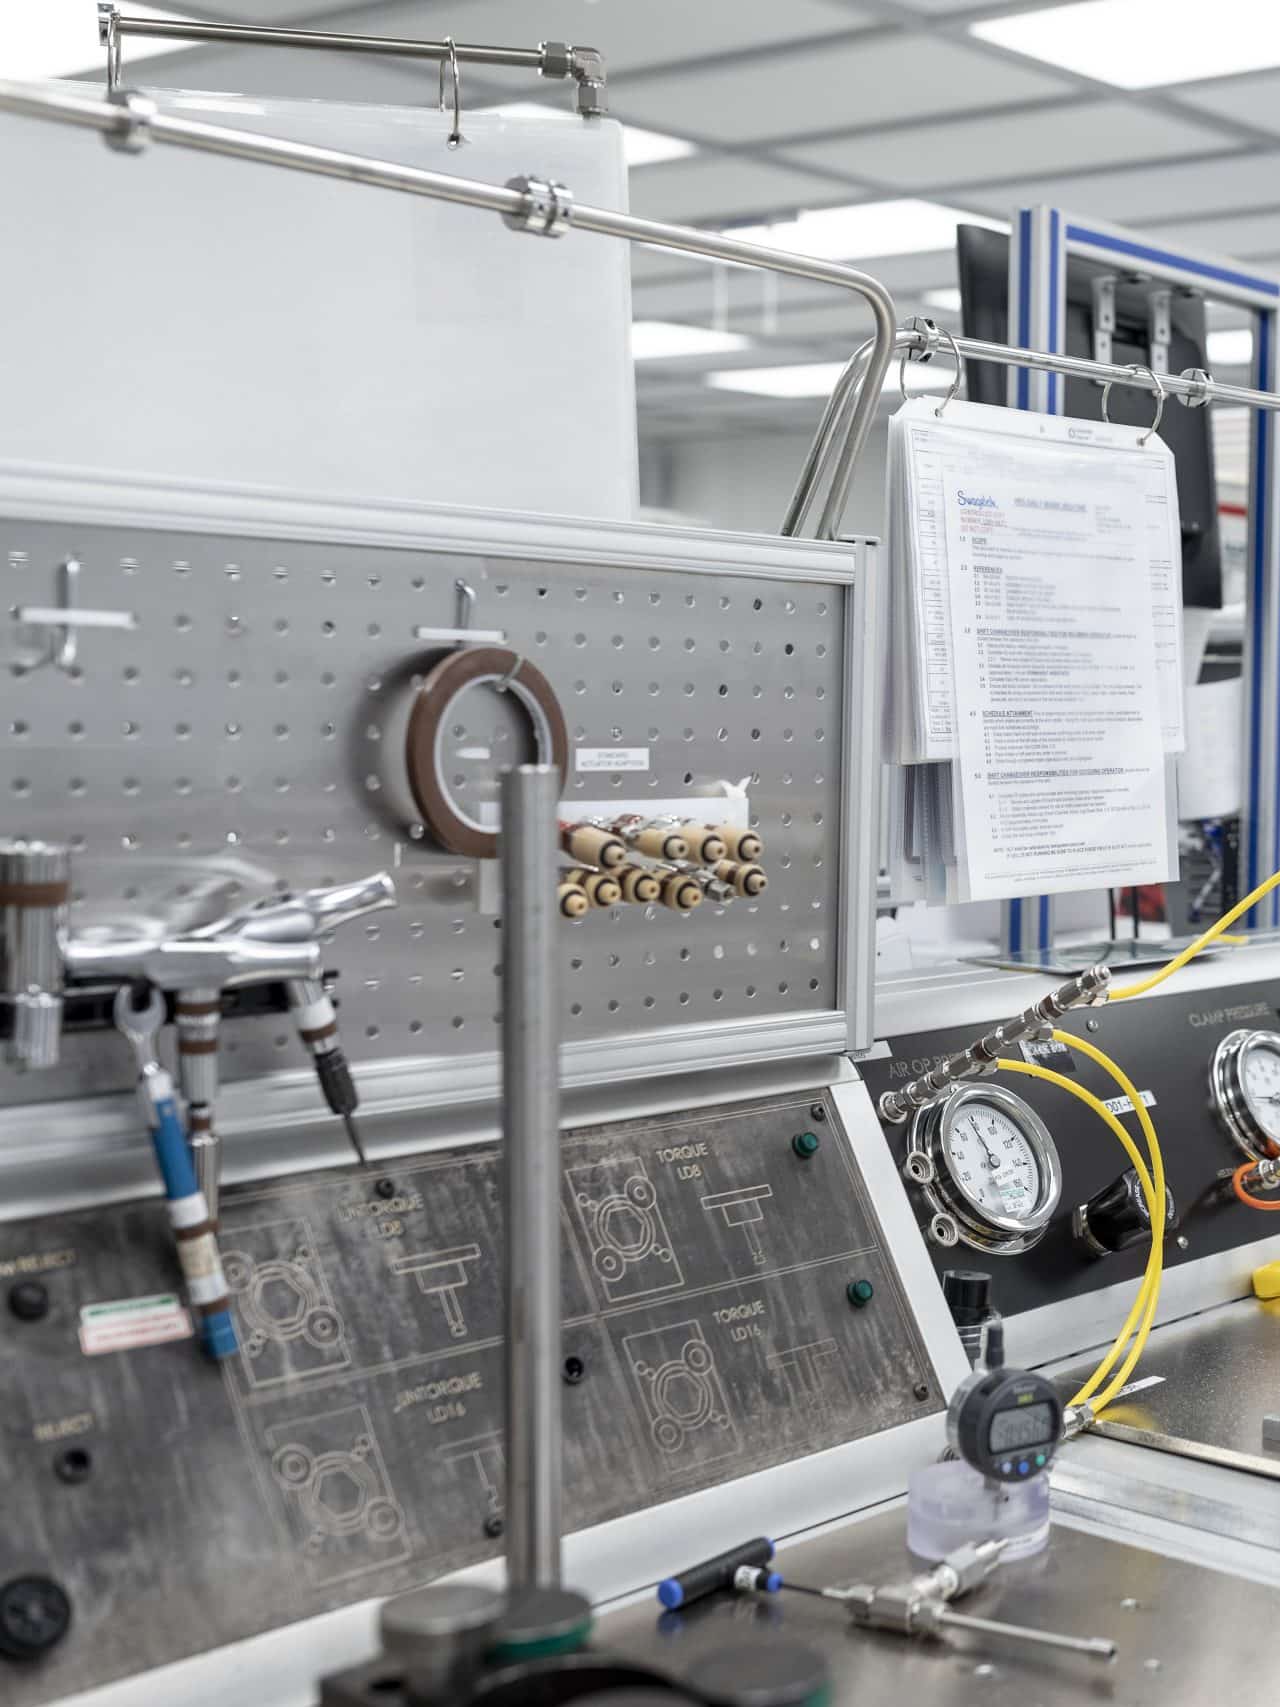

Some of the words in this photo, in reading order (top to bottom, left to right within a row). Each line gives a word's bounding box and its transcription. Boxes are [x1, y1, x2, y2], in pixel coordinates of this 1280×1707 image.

[889, 1061, 911, 1080] AIR
[655, 1142, 709, 1163] TORQUE
[677, 1163, 702, 1181] LD8
[711, 1299, 767, 1324] TORQUE
[730, 1322, 762, 1342] LD16
